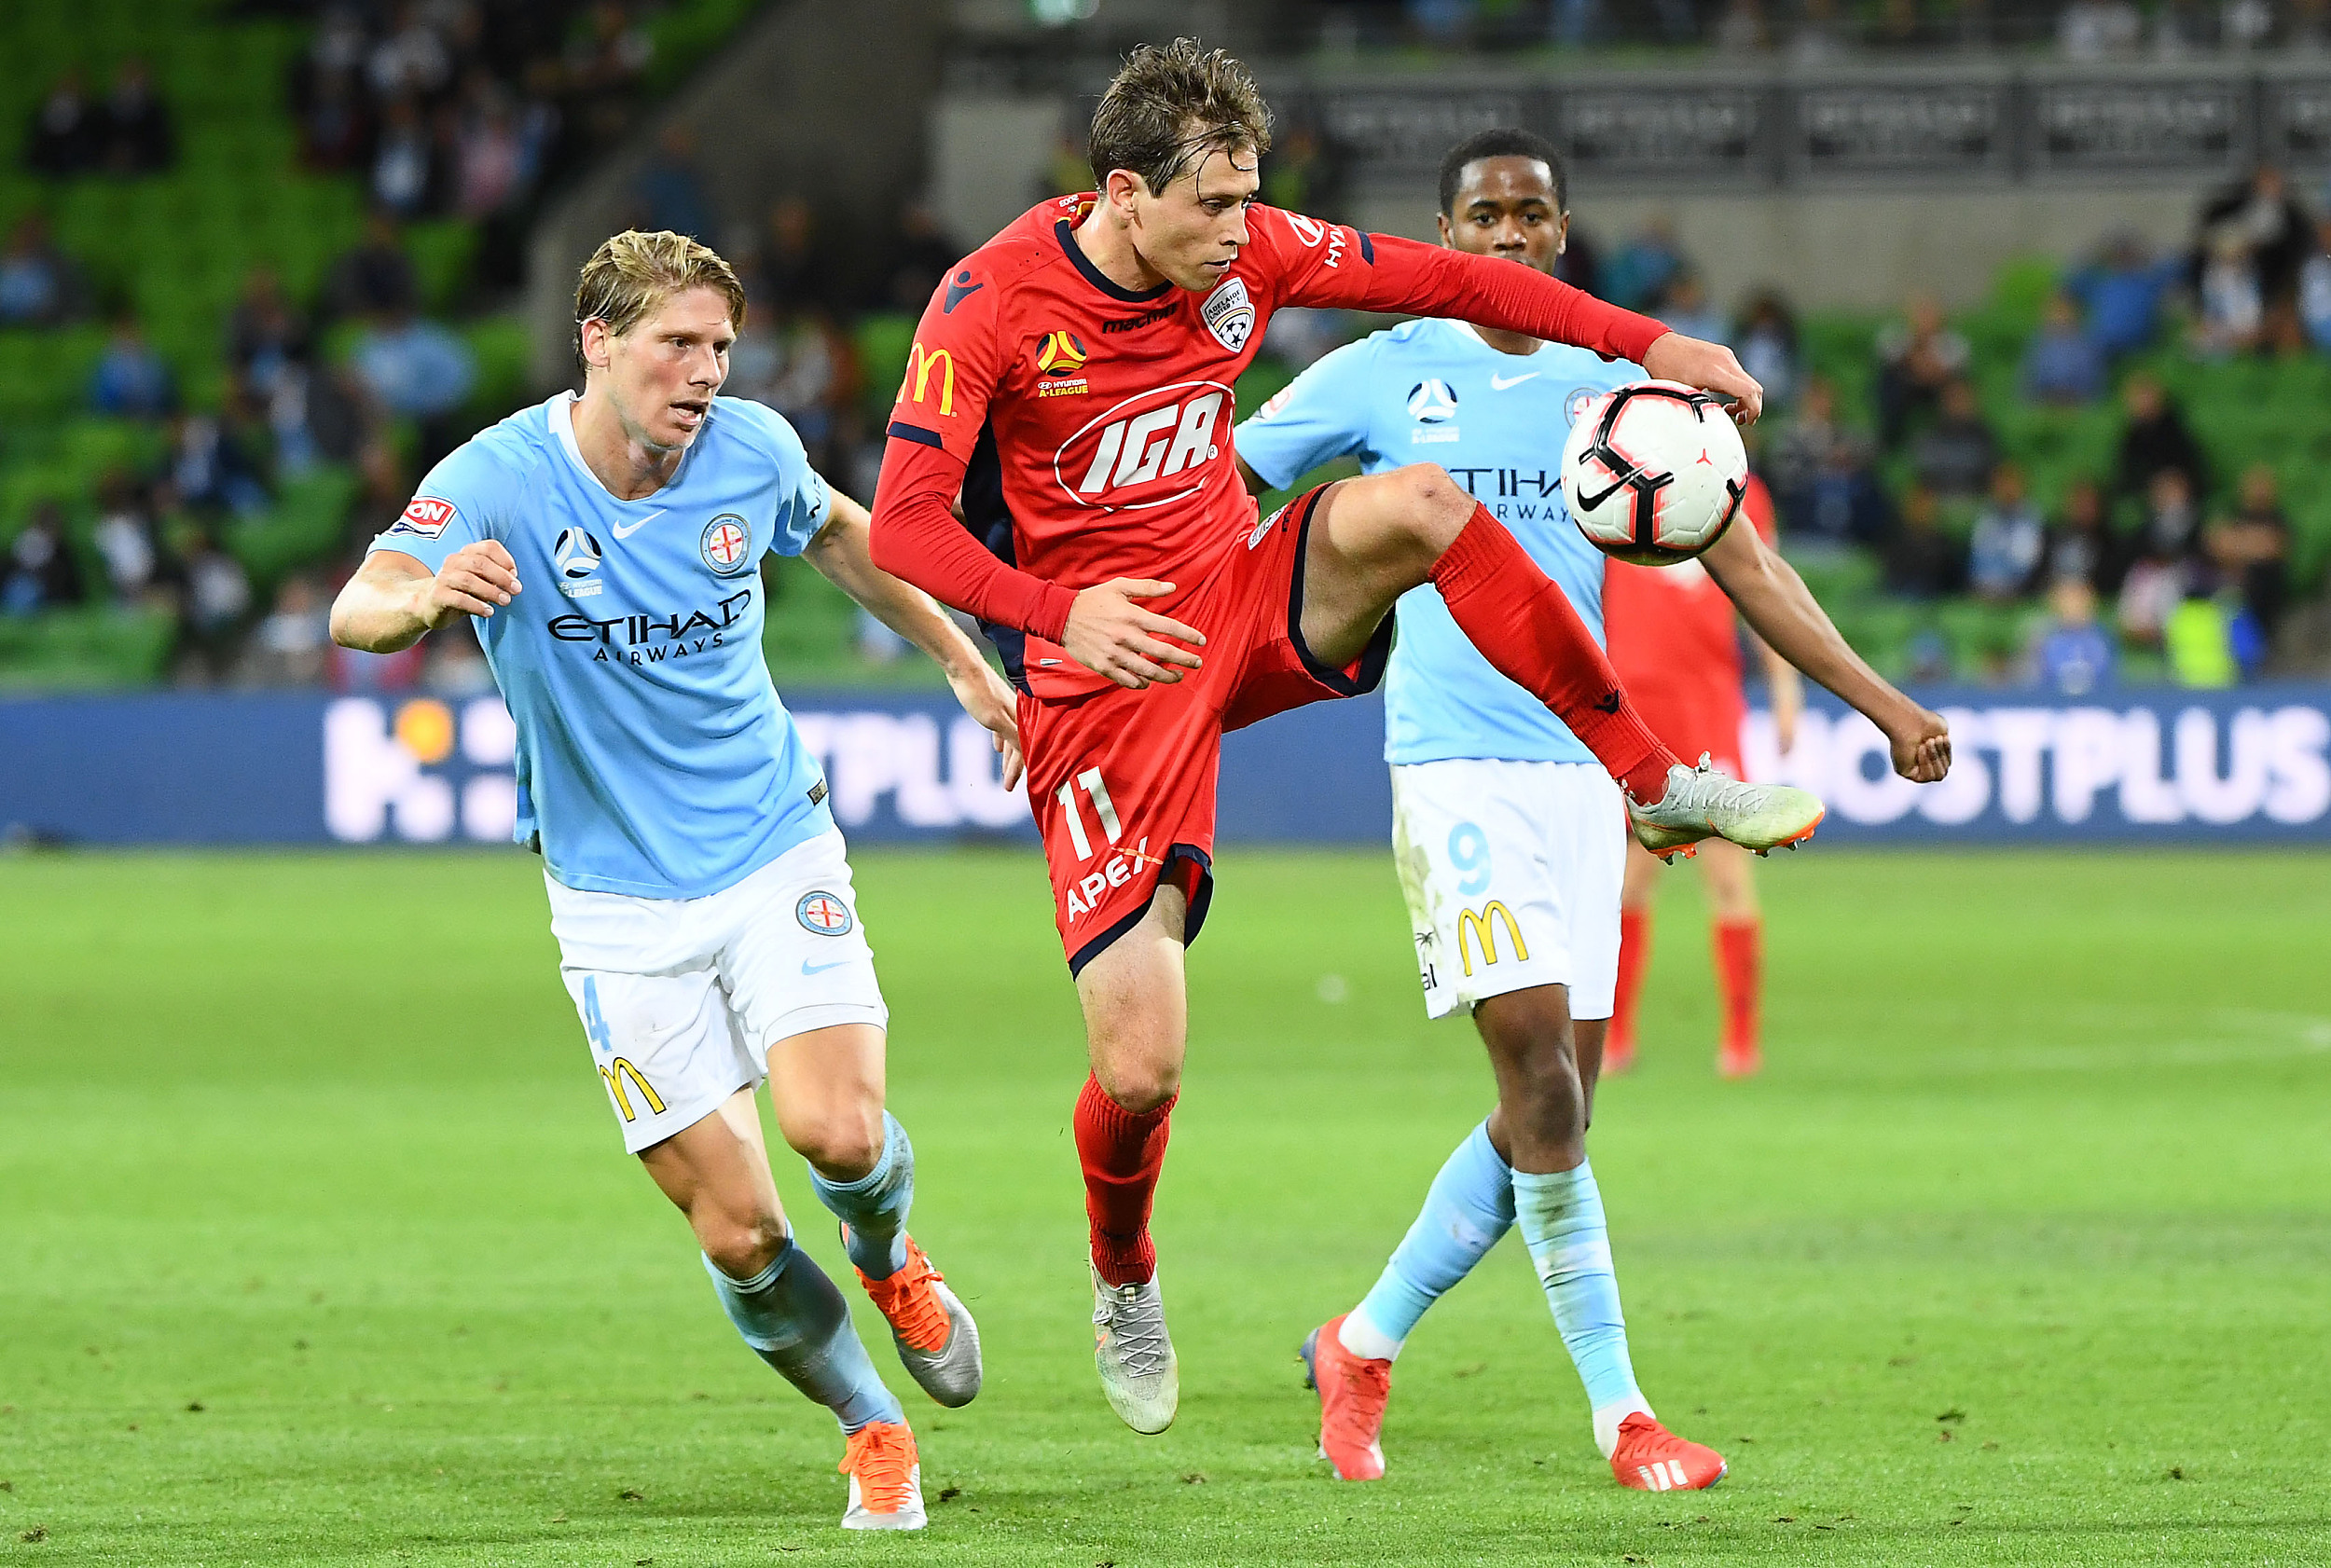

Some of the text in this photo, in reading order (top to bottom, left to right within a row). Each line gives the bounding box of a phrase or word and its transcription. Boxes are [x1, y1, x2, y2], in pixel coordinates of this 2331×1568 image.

[1207, 289, 1241, 315] ADELAIDE
[1209, 303, 1231, 320] UNITED
[1078, 391, 1223, 493] IGA
[1449, 468, 1563, 498] TIH
[547, 589, 751, 646] ETIHAD
[593, 632, 724, 666] AIRWAYS
[1055, 765, 1123, 862] 11
[1447, 821, 1492, 897] 9
[583, 974, 613, 1052] 4
